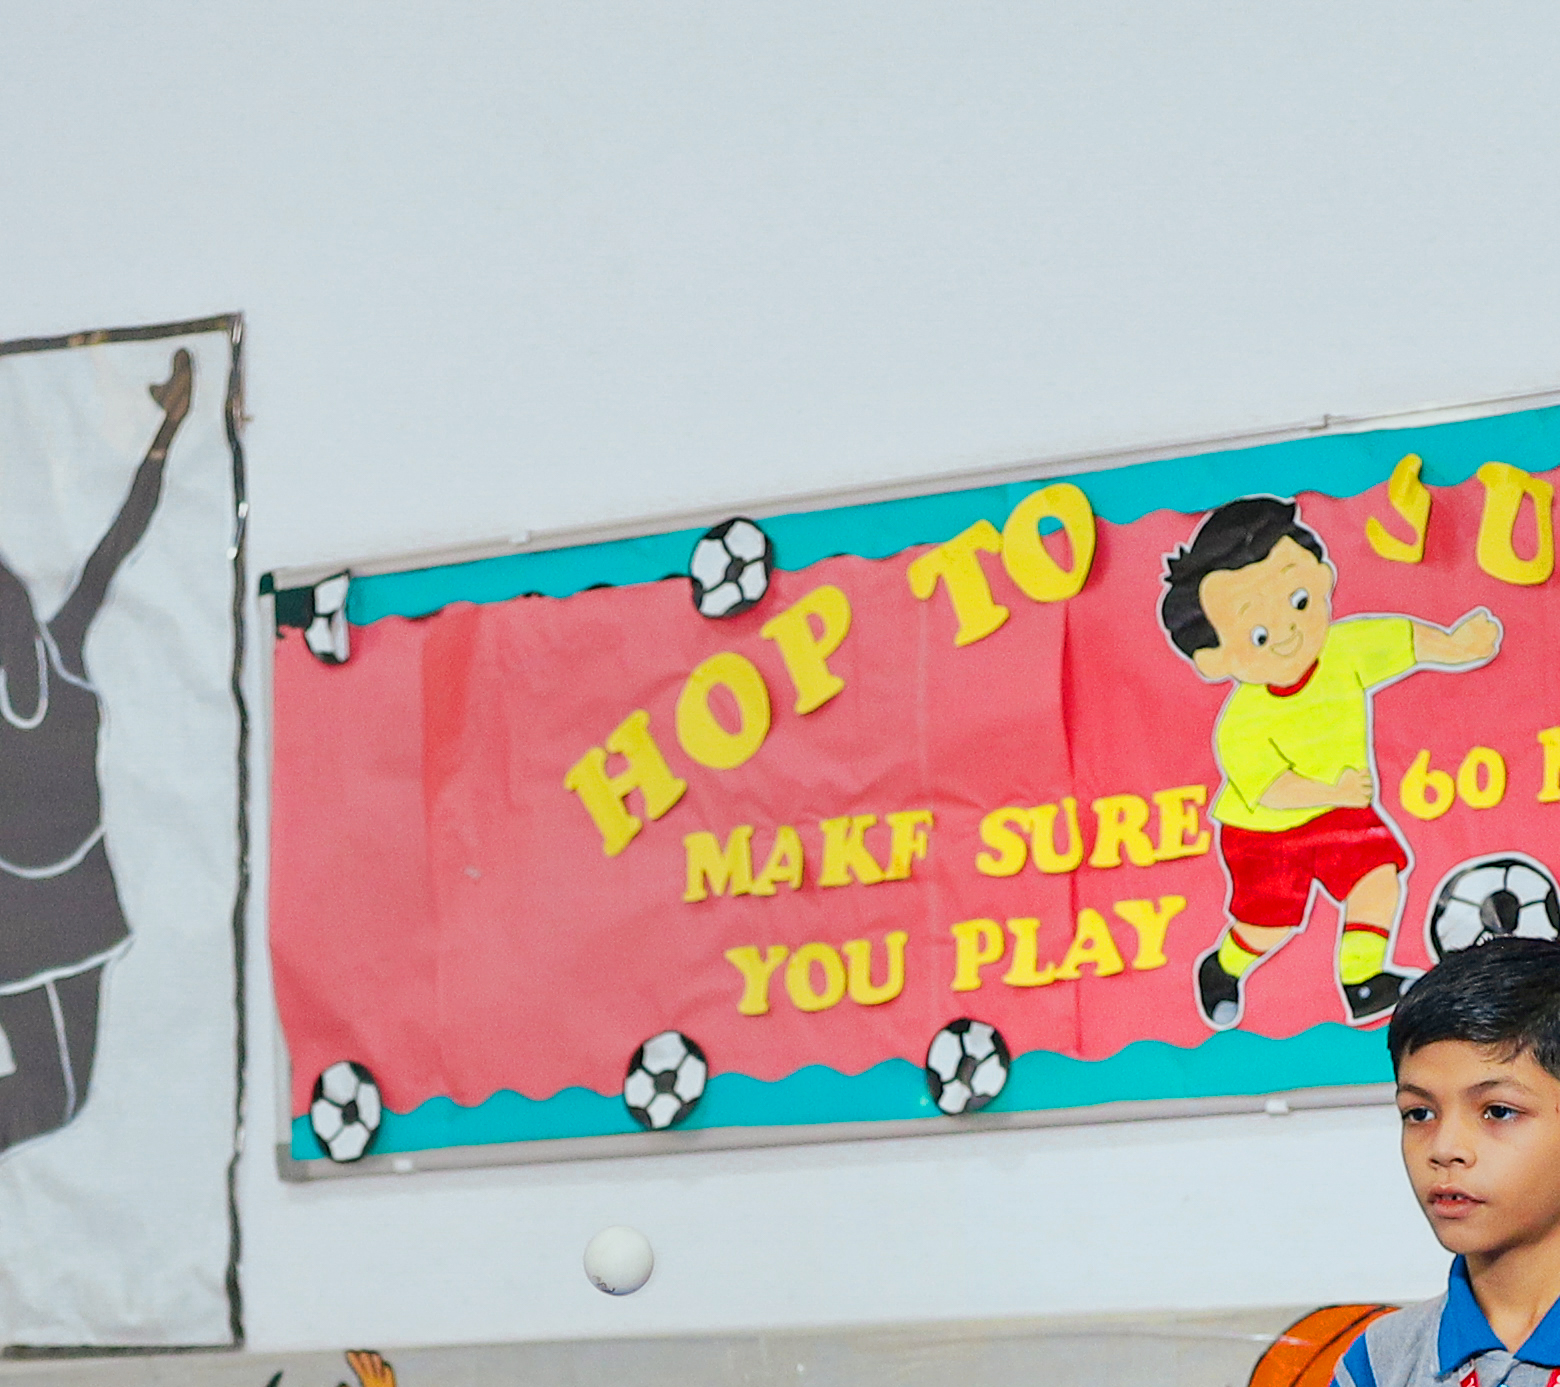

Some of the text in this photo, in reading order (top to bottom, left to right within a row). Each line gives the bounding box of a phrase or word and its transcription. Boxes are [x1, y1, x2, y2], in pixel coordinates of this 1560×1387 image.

[564, 584, 854, 857] HOP
[908, 484, 1098, 646] TO
[975, 785, 1212, 877] SURE
[1399, 747, 1508, 821] 60
[726, 895, 1187, 1016] YOU PLAY
